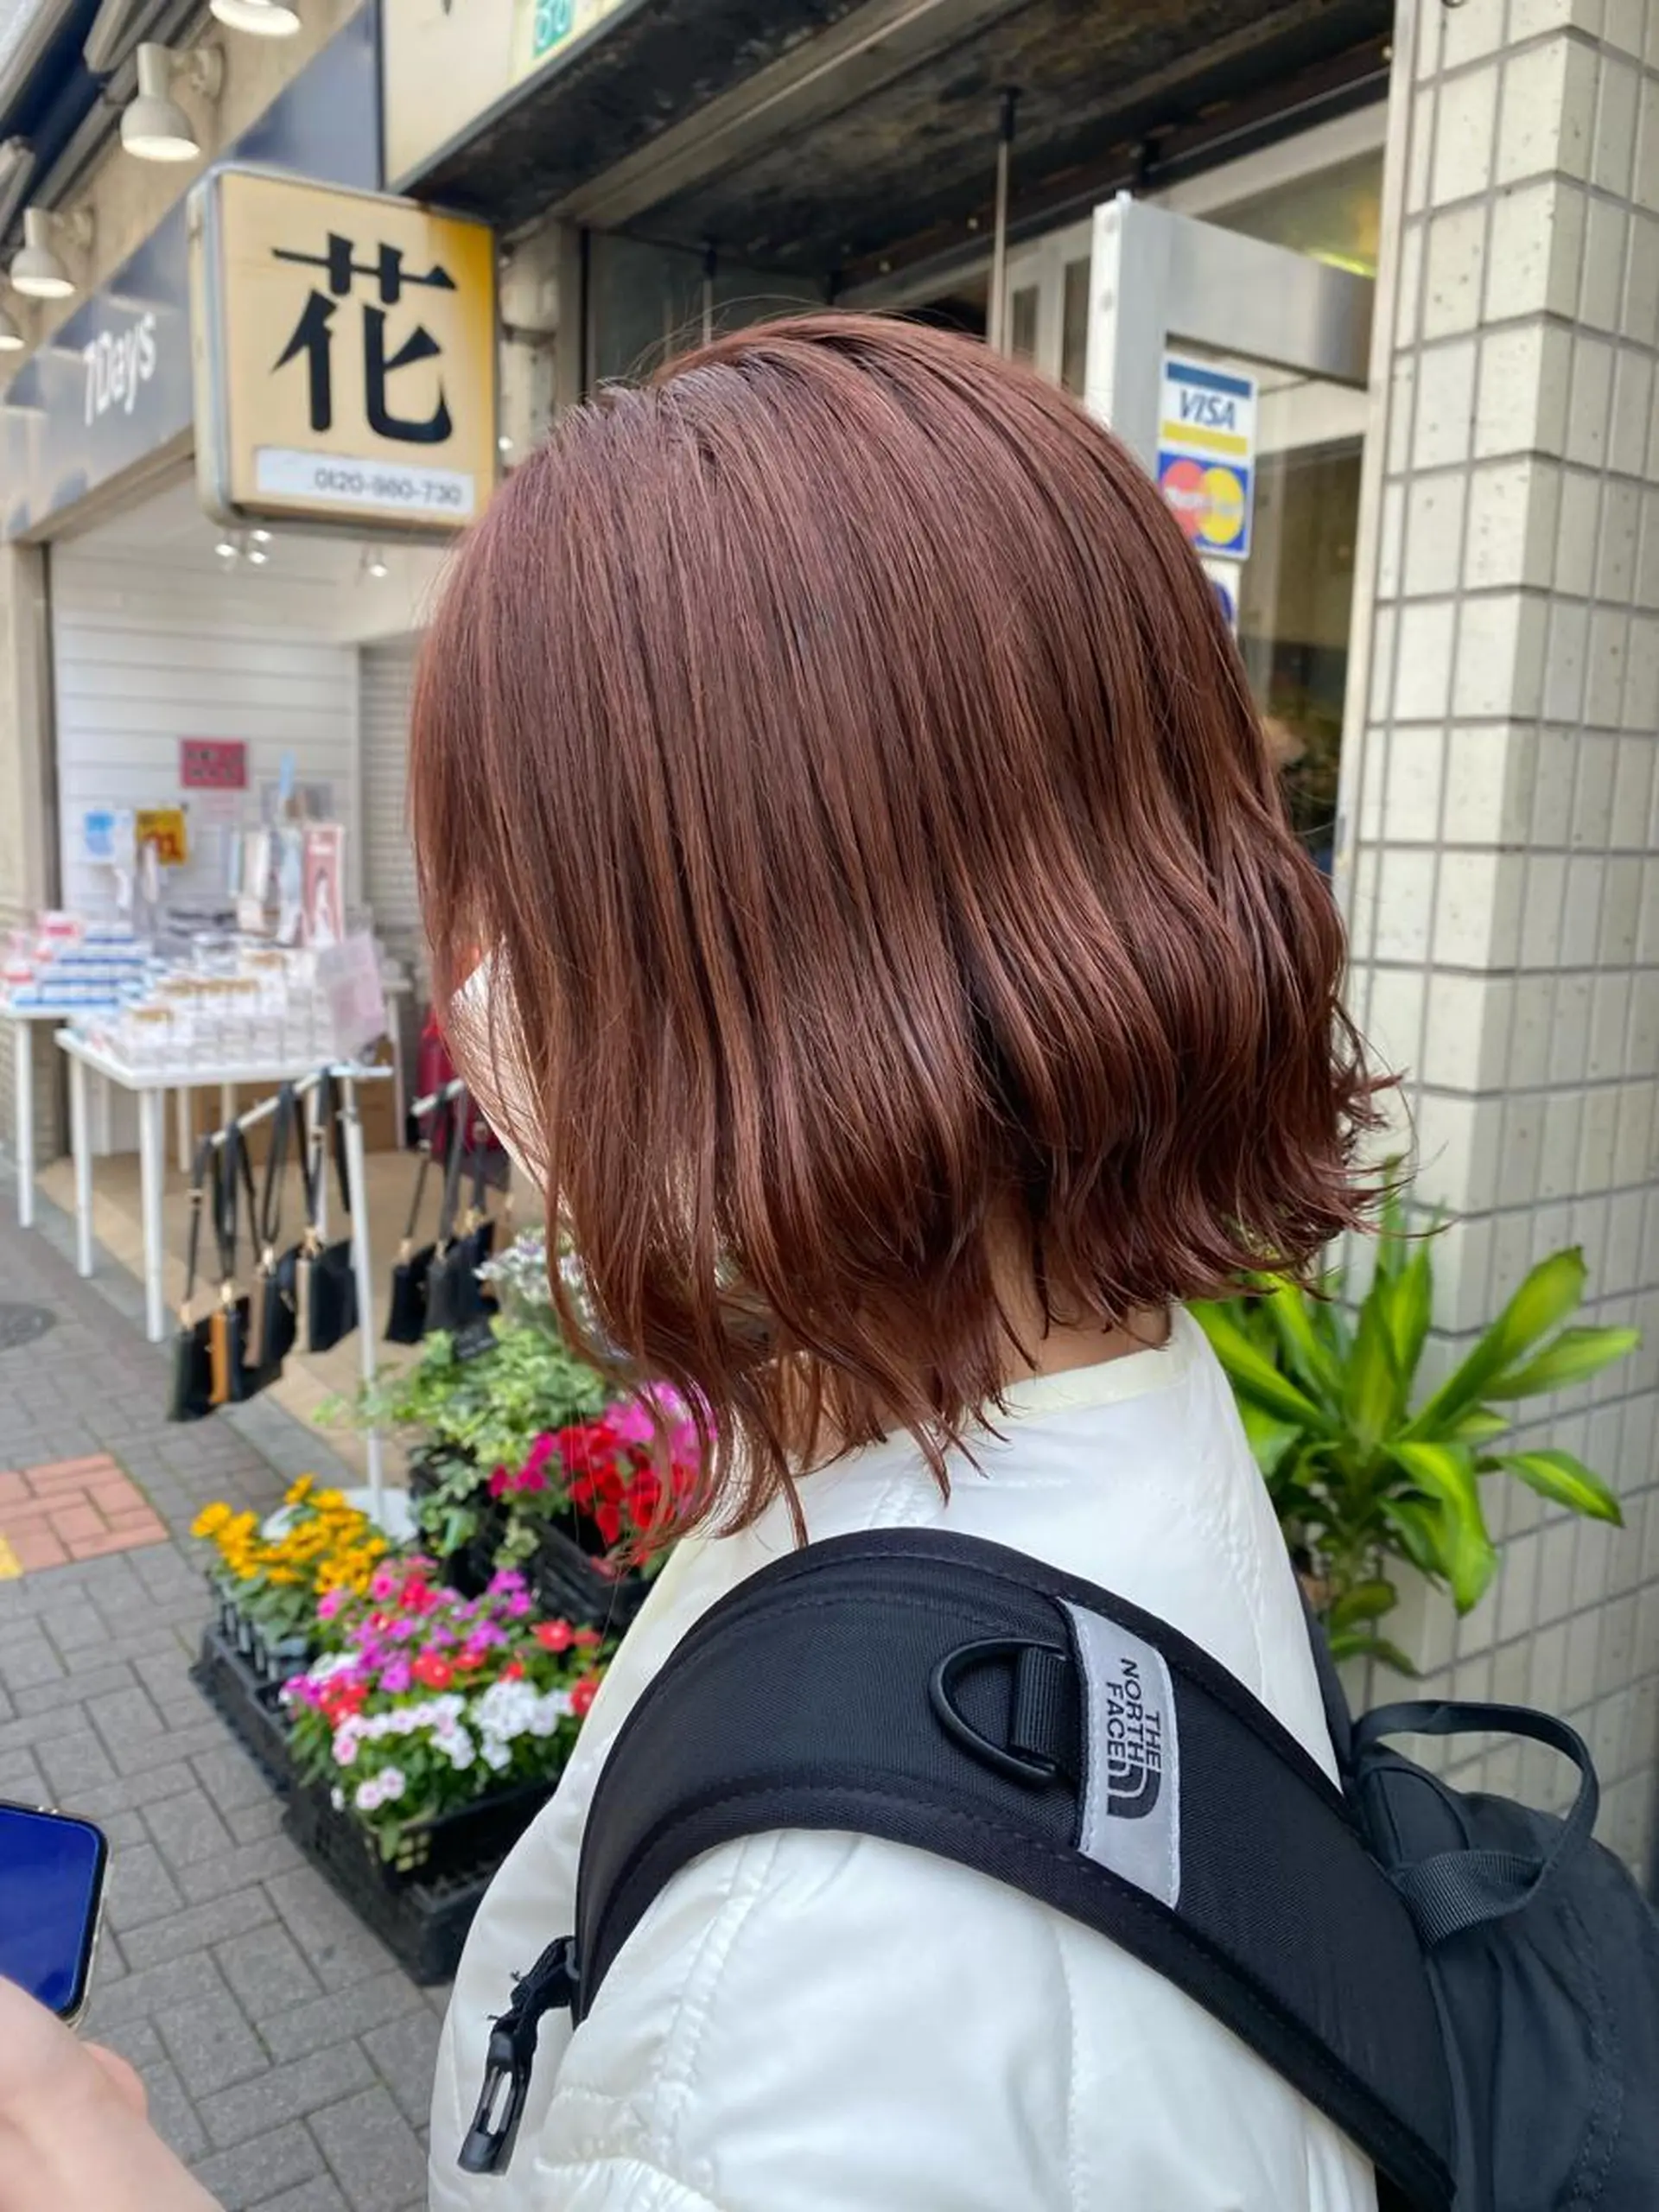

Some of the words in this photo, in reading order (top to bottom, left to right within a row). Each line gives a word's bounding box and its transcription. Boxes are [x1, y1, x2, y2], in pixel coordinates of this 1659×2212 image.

[270, 232, 458, 444] 花
[1180, 390, 1236, 430] VISA
[1106, 1681, 1125, 1758] FACE
[1121, 1658, 1144, 1762] NORTH
[1145, 1711, 1161, 1769] THE
